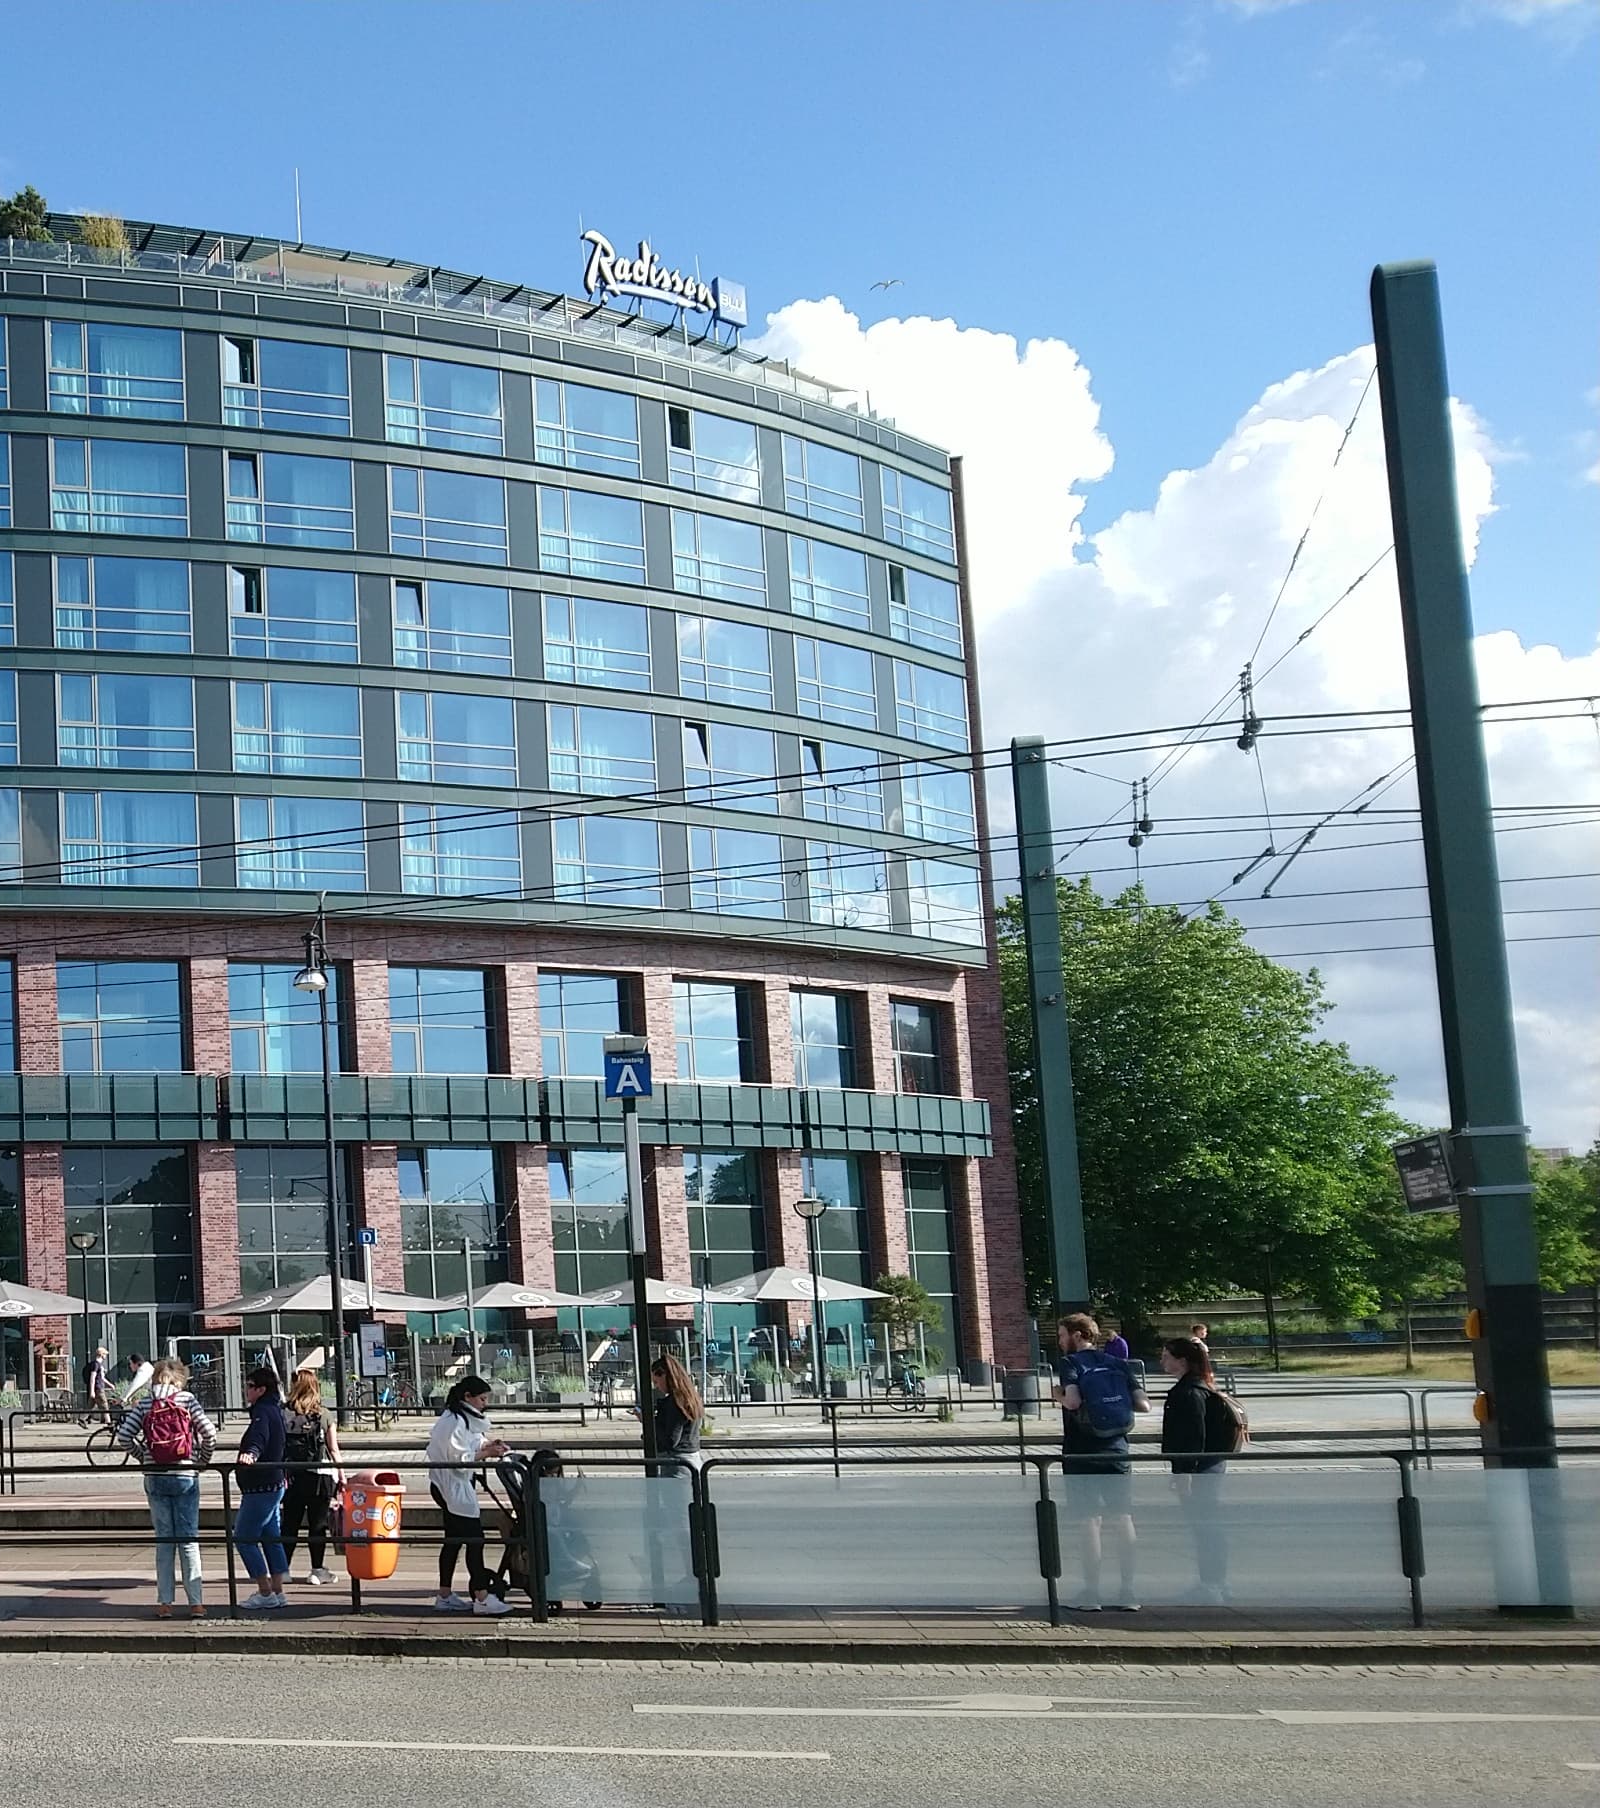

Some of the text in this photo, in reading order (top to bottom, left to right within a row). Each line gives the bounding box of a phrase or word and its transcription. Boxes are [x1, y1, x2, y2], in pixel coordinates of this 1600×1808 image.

[580, 230, 717, 310] Radisson
[615, 1064, 643, 1093] A
[363, 1232, 372, 1243] D
